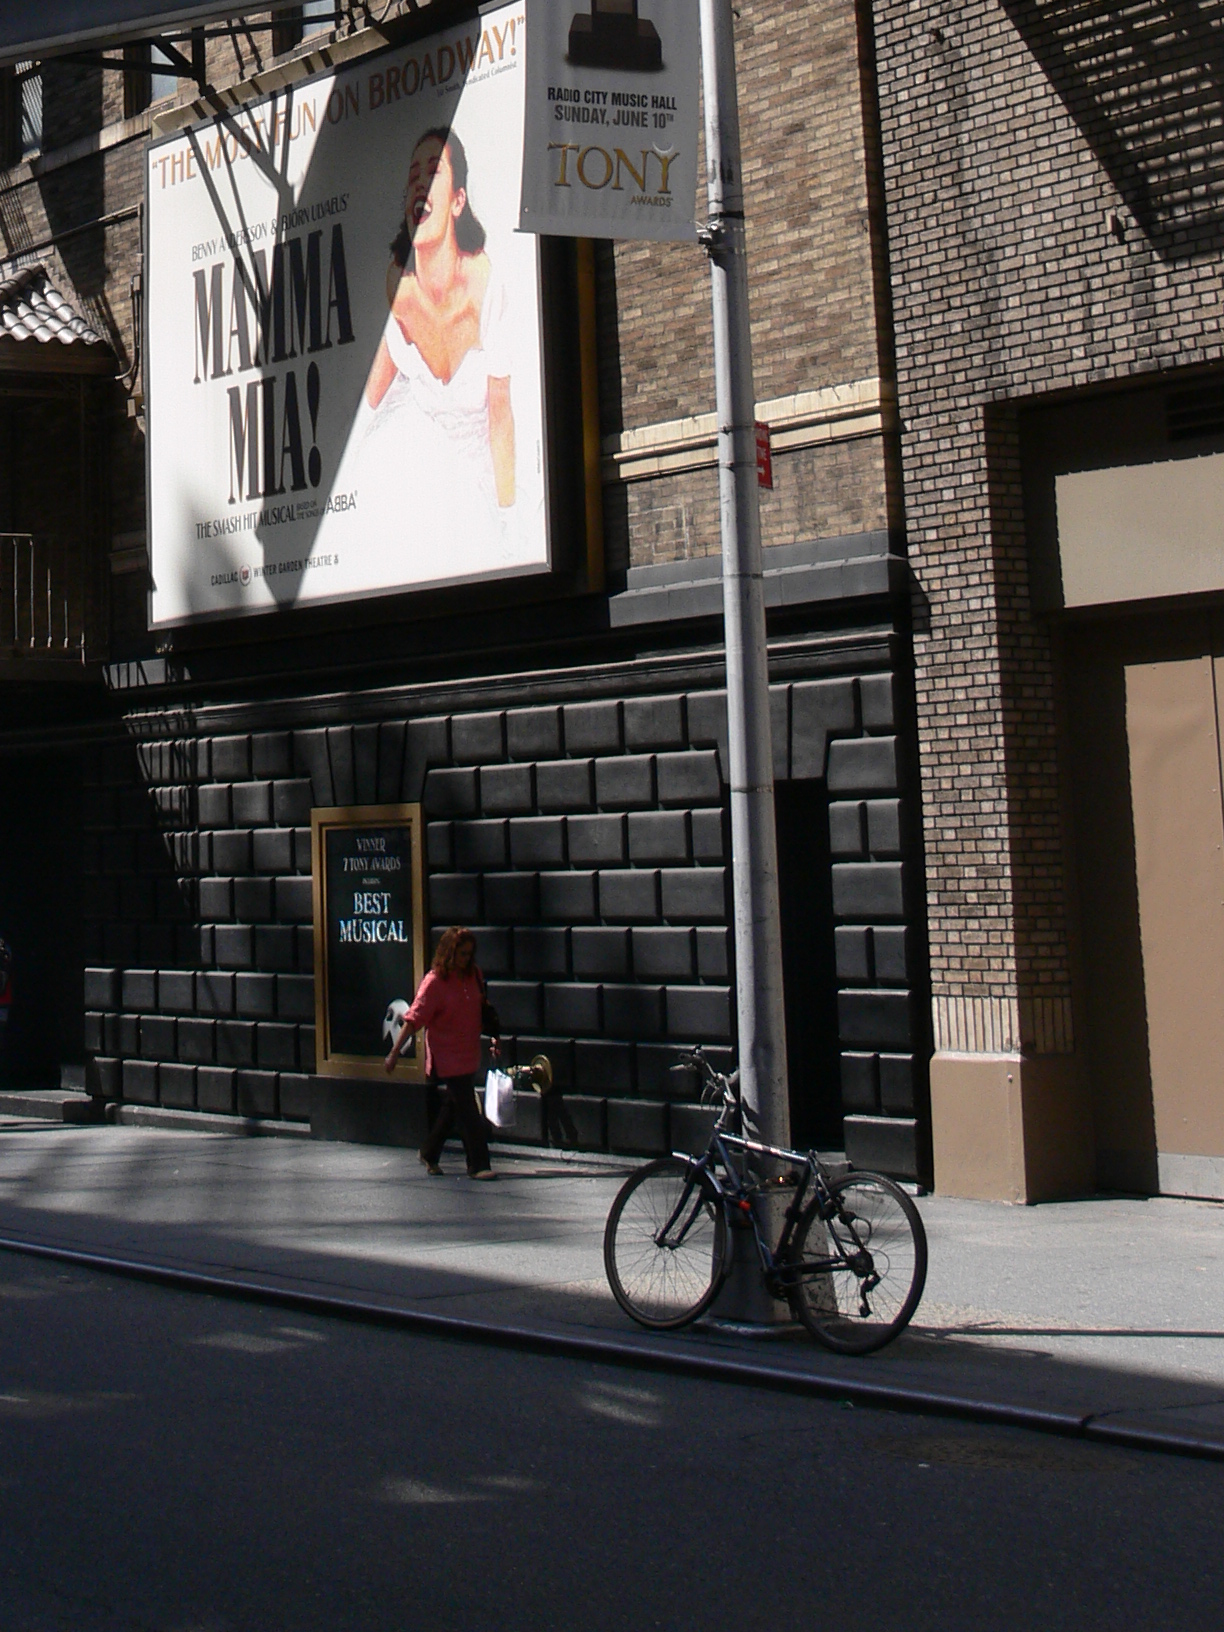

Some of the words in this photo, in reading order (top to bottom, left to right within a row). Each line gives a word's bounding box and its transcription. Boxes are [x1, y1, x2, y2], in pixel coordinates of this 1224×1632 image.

[547, 86, 581, 103] RADIO
[584, 89, 608, 105] CITY
[611, 92, 649, 109] MUSIC
[651, 95, 678, 111] HALL
[205, 117, 266, 172] MOST
[274, 98, 317, 147] FUN
[326, 80, 360, 126] ON
[554, 104, 611, 128] SUNDAY,
[613, 110, 649, 129] JUNE
[547, 141, 681, 195] TONY
[630, 195, 673, 208] AWARDS
[191, 237, 219, 262] BENNY
[218, 221, 268, 252] ANDERSSON
[270, 218, 278, 235] &
[192, 223, 356, 385] MAMMA
[226, 360, 323, 506] MIA!
[194, 521, 212, 540] THE
[212, 514, 242, 538] SMASH
[243, 511, 259, 531] HIT
[259, 504, 297, 528] MUSICAL
[210, 571, 239, 586] CADILLAC
[253, 565, 277, 578] WINTER
[278, 560, 303, 575] GARDEN
[304, 554, 332, 569] THEATRE
[356, 837, 386, 853] WINNER
[342, 857, 349, 872] 7
[349, 856, 369, 871] TONY
[370, 856, 402, 872] AWARDS
[353, 891, 392, 916] BEST
[338, 918, 409, 944] MUSICAL
